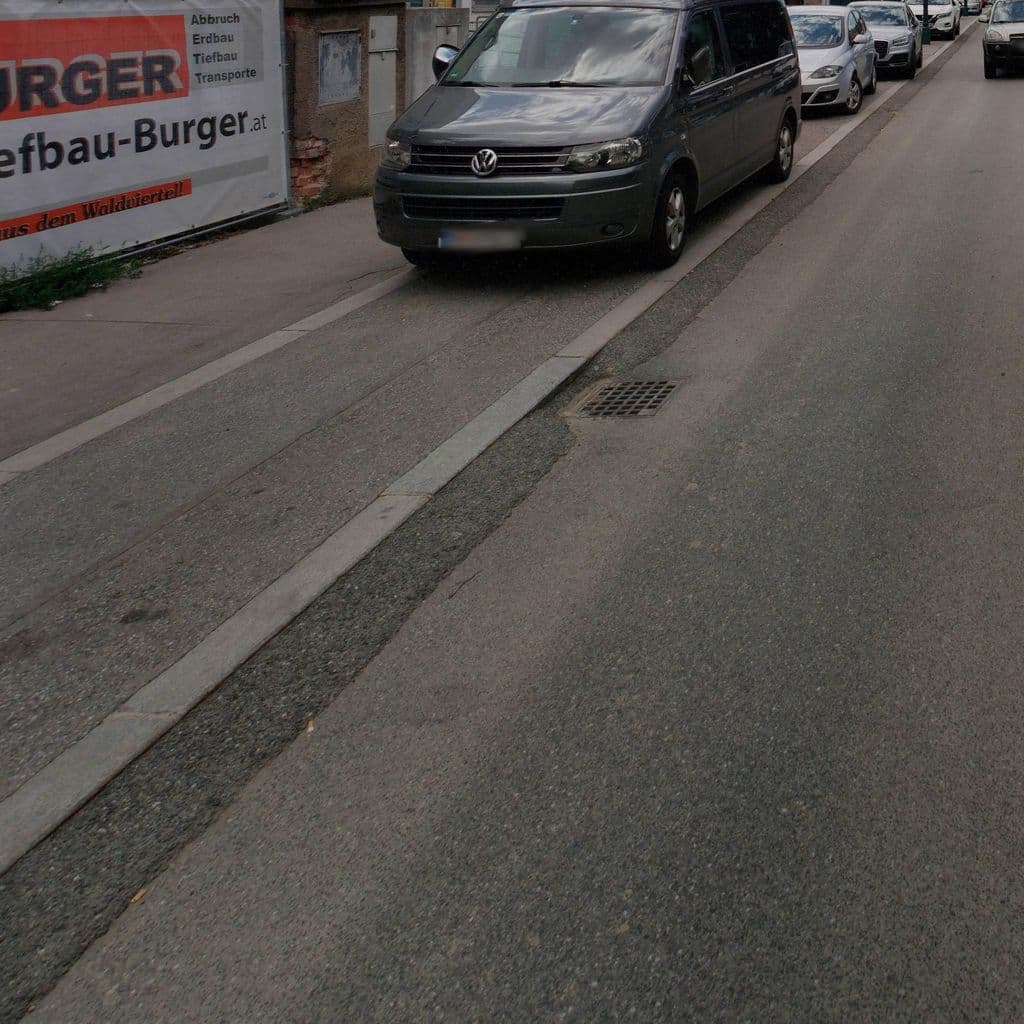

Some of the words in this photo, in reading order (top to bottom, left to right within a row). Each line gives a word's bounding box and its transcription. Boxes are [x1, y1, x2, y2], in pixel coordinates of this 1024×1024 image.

[191, 13, 240, 26] Abbruch
[192, 34, 234, 45] Erdbau
[193, 52, 237, 65] Tiefbau
[195, 68, 256, 84] Transporte
[37, 213, 76, 232] dem
